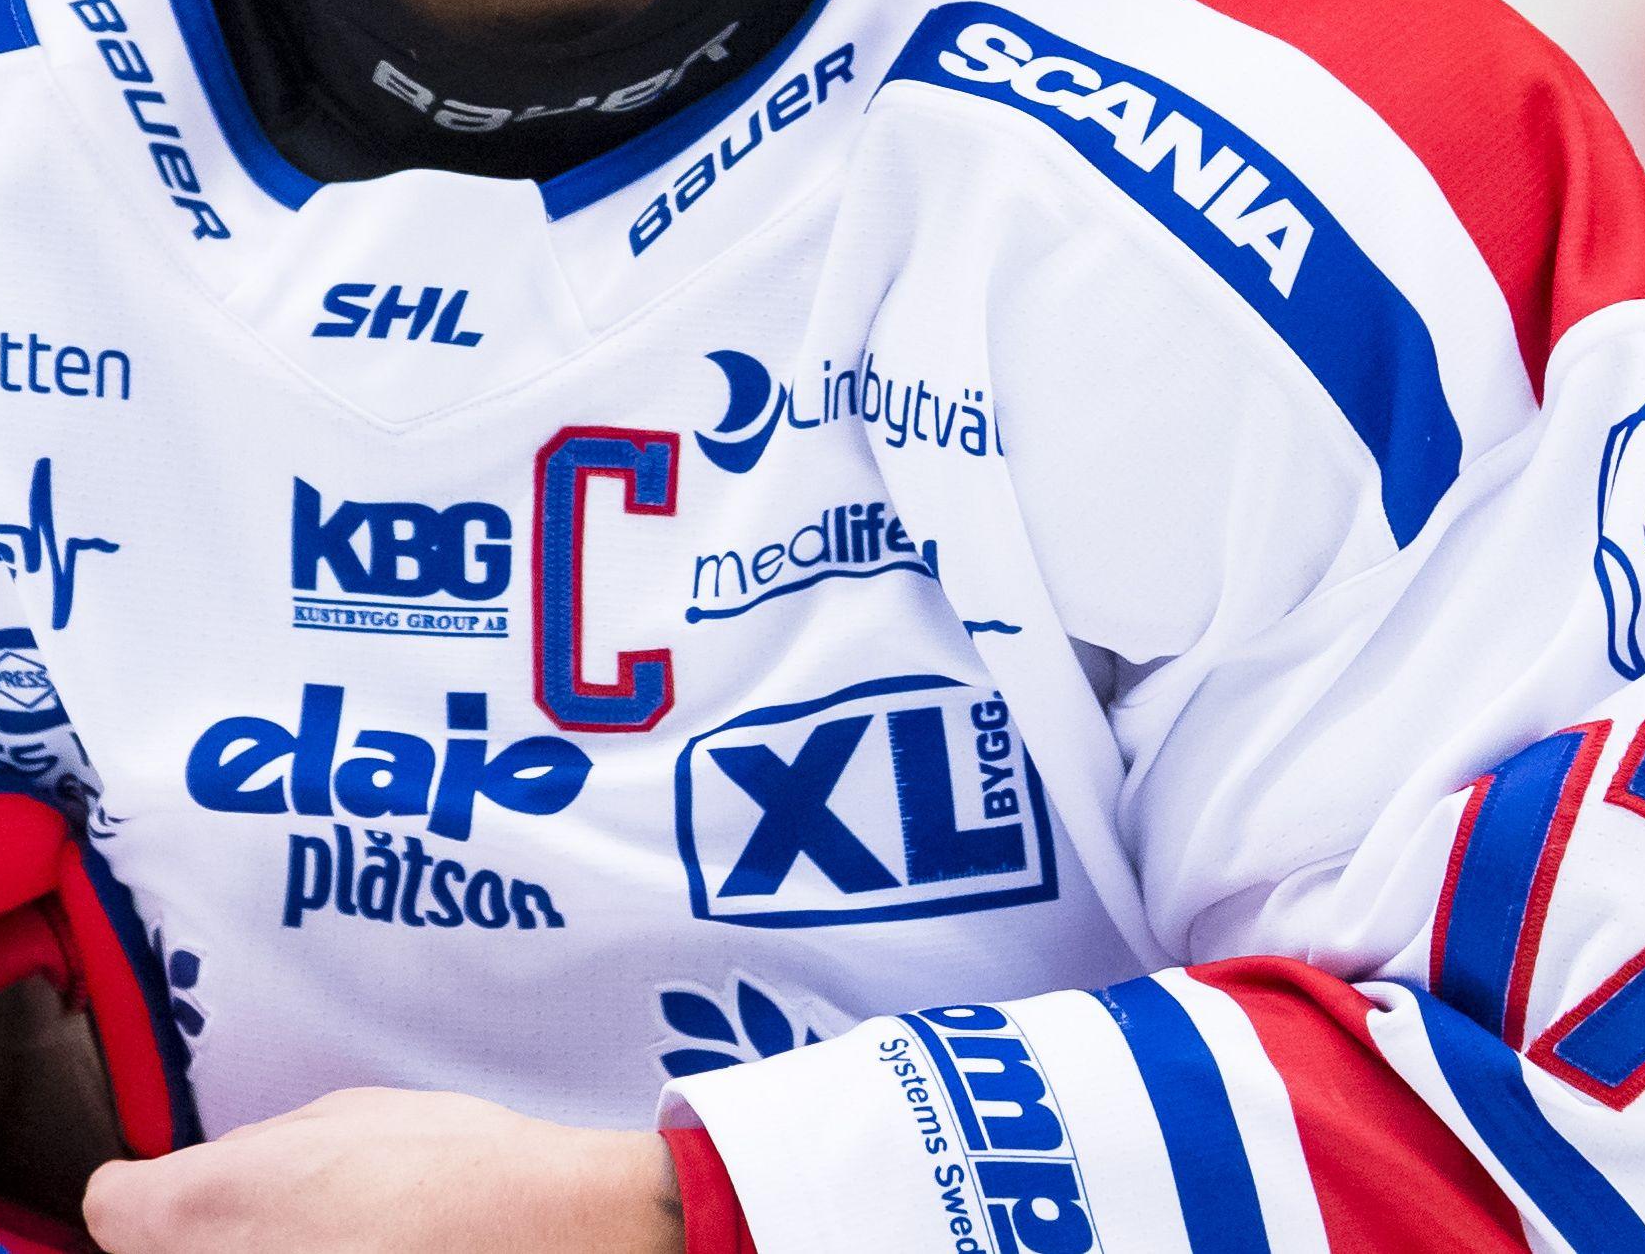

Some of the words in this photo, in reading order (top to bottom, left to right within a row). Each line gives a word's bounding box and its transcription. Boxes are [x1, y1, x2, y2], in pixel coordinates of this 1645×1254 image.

[628, 44, 855, 257] BAUER
[938, 22, 1315, 300] SCANIA
[312, 283, 484, 346] SHL
[291, 476, 512, 601] KBG
[532, 427, 679, 733] C
[293, 606, 398, 627] KUSTBYGG
[407, 614, 479, 630] GROUP
[484, 616, 507, 631] AB
[185, 683, 593, 842] elajo
[707, 707, 1026, 899] XL
[282, 823, 565, 929] plåtson
[880, 1038, 948, 1156] Systems
